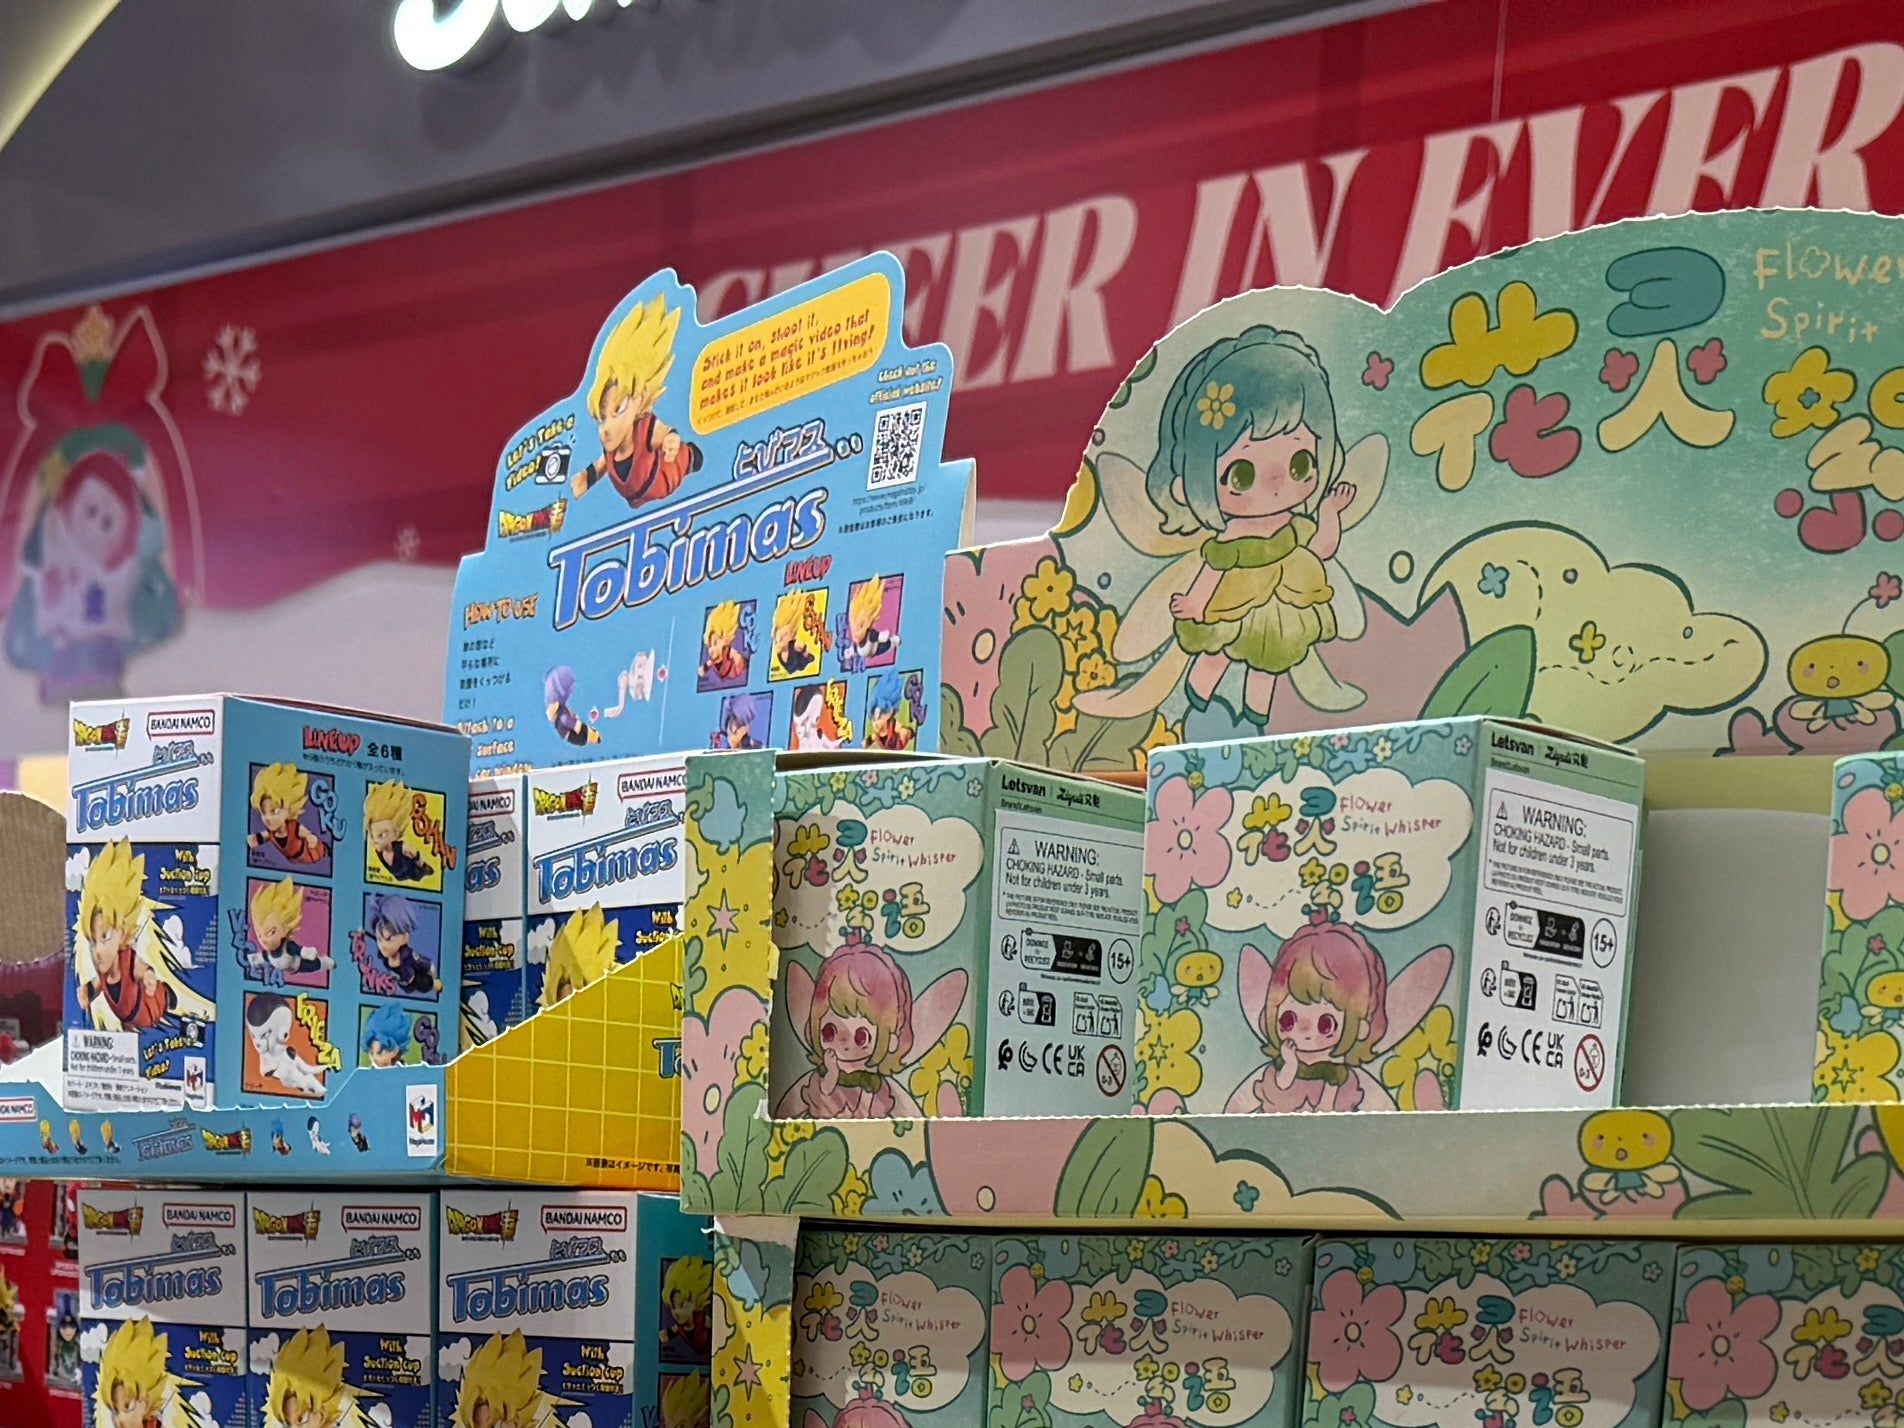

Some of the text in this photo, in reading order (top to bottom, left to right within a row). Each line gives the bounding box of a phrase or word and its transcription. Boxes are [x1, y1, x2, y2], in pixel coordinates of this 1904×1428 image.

[1173, 150, 1368, 335] IN
[1758, 295, 1877, 343] Spirit
[770, 340, 804, 363] magic
[809, 324, 841, 345] video
[845, 309, 870, 331] that
[752, 370, 777, 389] look
[549, 488, 829, 628] Tobimas
[784, 556, 832, 586] LINEUP
[463, 600, 492, 630] HOW
[494, 597, 513, 620] TO
[150, 715, 212, 731] BANDAI NAMCO
[1522, 805, 1587, 837] WARNING:
[1494, 822, 1532, 847] CHOKING
[1533, 831, 1563, 853] HAZARD
[1594, 933, 1614, 955] 15+
[446, 1272, 609, 1322] Tobimas
